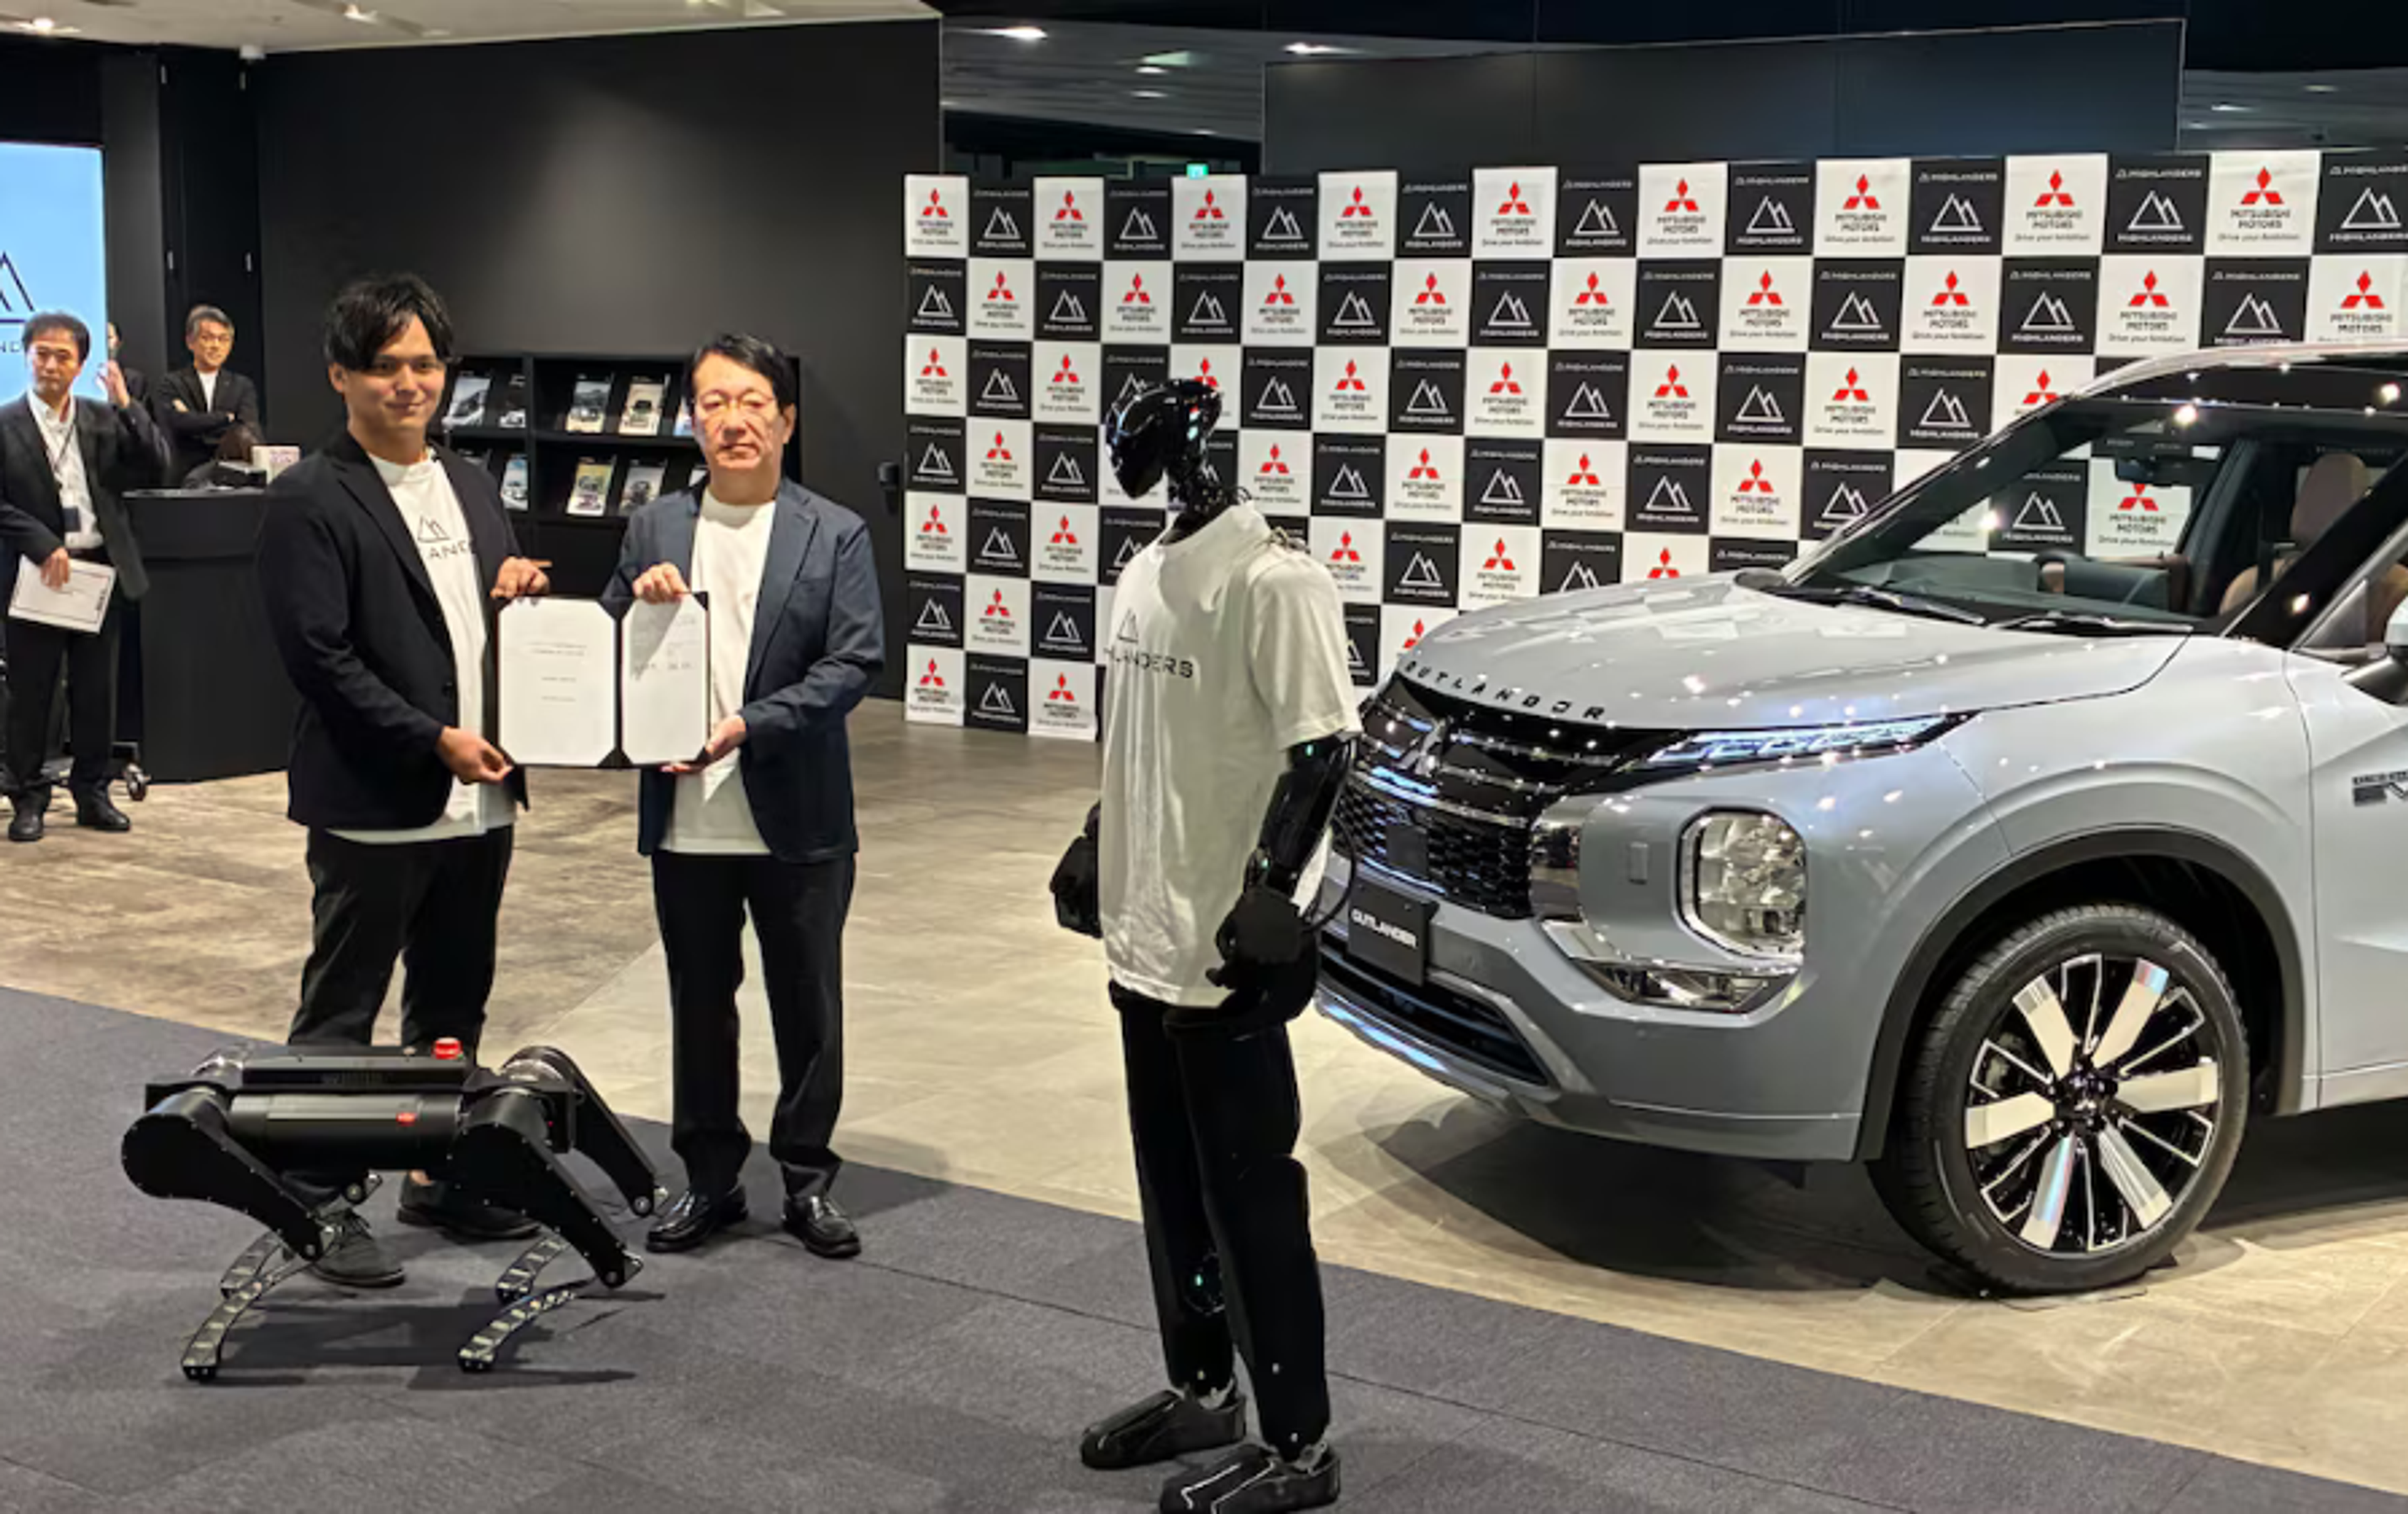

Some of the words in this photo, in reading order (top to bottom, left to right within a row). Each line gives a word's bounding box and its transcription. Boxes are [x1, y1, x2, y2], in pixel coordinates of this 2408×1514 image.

[1931, 173, 1998, 182] HIGHLANDERS
[2128, 169, 2202, 179] HIGHLANDERS
[1573, 180, 1632, 189] HIGHLANDERS
[1746, 176, 1809, 185] HIGHLANDERS
[1835, 213, 1886, 221] MITSUBISHI
[2026, 210, 2081, 218] MITSUBISHI
[2231, 209, 2291, 218] MITSUBISHI
[1491, 218, 1536, 226] MITSUBISHI
[1657, 215, 1705, 224] MITSUBISHI
[1841, 223, 1879, 232] MOTORS
[2032, 221, 2073, 229] MOTORS
[2237, 220, 2282, 229] MOTORS
[1496, 227, 1529, 235] MOTORS
[1662, 225, 1698, 234] MOTORS
[1736, 236, 1802, 244] HIGHLANDERS
[1921, 234, 1990, 243] HIGHLANDERS
[2116, 233, 2193, 242] HIGHLANDERS
[1831, 272, 1896, 280] HIGHLANDERS
[2022, 271, 2091, 280] HIGHLANDERS
[2225, 273, 2300, 281] HIGHLANDERS
[1923, 310, 1977, 318] MITSUBISHI
[2120, 311, 2177, 320] MITSUBISHI
[2330, 313, 2392, 322] MITSUBISHI
[1745, 318, 1782, 327] MOTORS
[1929, 320, 1968, 329] MOTORS
[2126, 322, 2168, 330] MOTORS
[1480, 329, 1538, 337] HIGHLANDERS
[2337, 324, 2383, 334] MOTORS
[1644, 330, 1707, 339] HIGHLANDERS
[1821, 332, 1889, 340] HIGHLANDERS
[2011, 333, 2083, 342] HIGHLANDERS
[1736, 366, 1798, 374] HIGHLANDERS
[1920, 369, 1987, 377] HIGHLANDERS
[1482, 396, 1527, 405] MITSUBISHI
[1647, 401, 1695, 409] MITSUBISHI
[1488, 406, 1521, 414] MOTORS
[1824, 404, 1876, 413] MITSUBISHI
[1652, 410, 1687, 419] MOTORS
[1556, 420, 1617, 428] HIGHLANDERS
[1830, 415, 1868, 424] MOTORS
[1726, 424, 1792, 433] HIGHLANDERS
[1909, 429, 1978, 439] HIGHLANDERS
[1645, 456, 1704, 466] HIGHLANDERS
[1822, 463, 1886, 472] HIGHLANDERS
[1560, 488, 1606, 497] MITSUBISHI
[1565, 498, 1599, 507] MOTORS
[1730, 495, 1780, 504] MITSUBISHI
[1473, 505, 1531, 515] HIGHLANDERS
[1736, 505, 1772, 515] MOTORS
[1637, 513, 1699, 523] HIGHLANDERS
[2108, 513, 2165, 523] MITSUBISHI
[2115, 524, 2156, 534] MOTORS
[2000, 532, 2072, 542] HIGHLANDERS
[1558, 542, 1615, 552] HIGHLANDERS
[1727, 551, 1788, 562] HIGHLANDERS
[1477, 572, 1521, 581] MITSUBISHI
[1482, 581, 1514, 591] MOTORS
[1351, 908, 1417, 949] OUTLANDER
